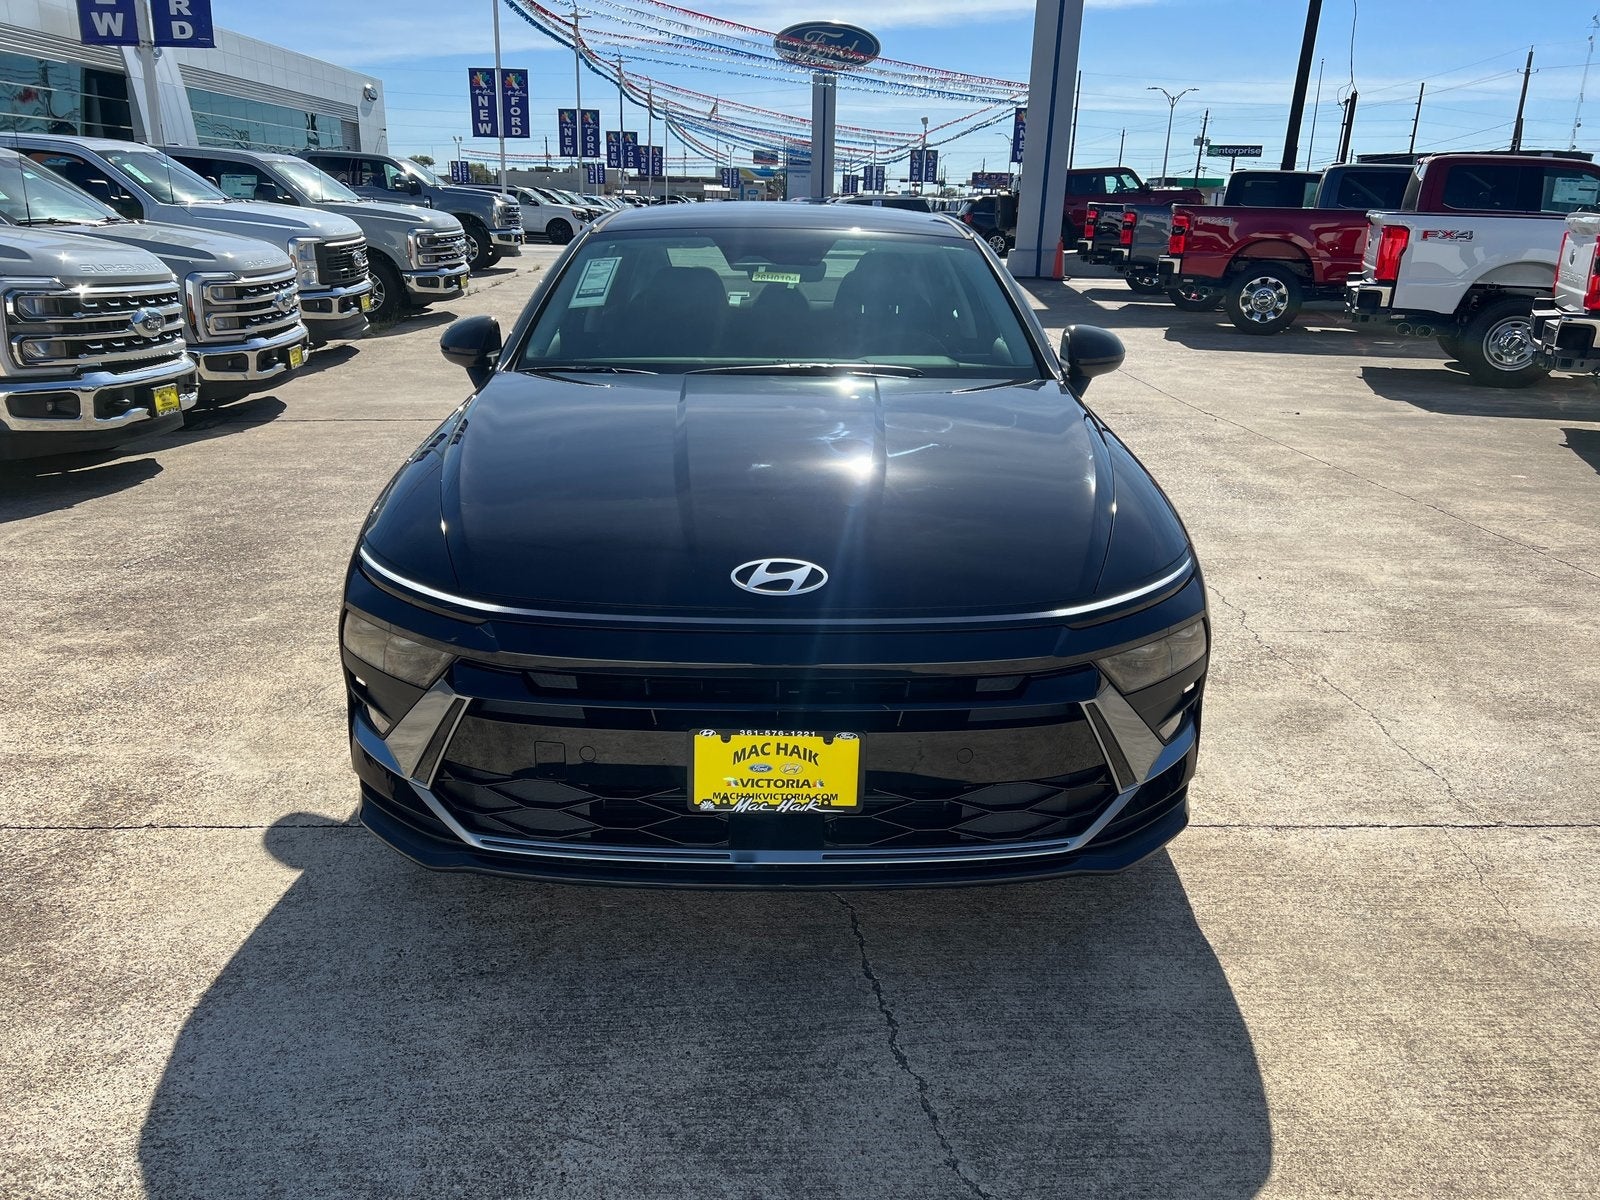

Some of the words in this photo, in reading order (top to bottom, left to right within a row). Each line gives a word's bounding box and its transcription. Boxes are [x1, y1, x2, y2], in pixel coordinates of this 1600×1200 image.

[797, 30, 859, 59] Ford
[477, 96, 492, 134] NEW
[510, 97, 522, 136] FORD
[563, 128, 574, 155] NEW
[587, 129, 595, 156] FORD
[1210, 147, 1262, 156] enterprise
[610, 146, 618, 167] NEW
[912, 162, 920, 181] NEW
[1197, 216, 1233, 225] FX4
[1421, 230, 1474, 241] FX4
[739, 729, 816, 738] 361-576-1221
[732, 742, 771, 766] MAC
[775, 742, 819, 767] HAIK
[739, 778, 812, 789] VICTORIA
[732, 797, 769, 814] Mac
[776, 797, 821, 813] Haik
